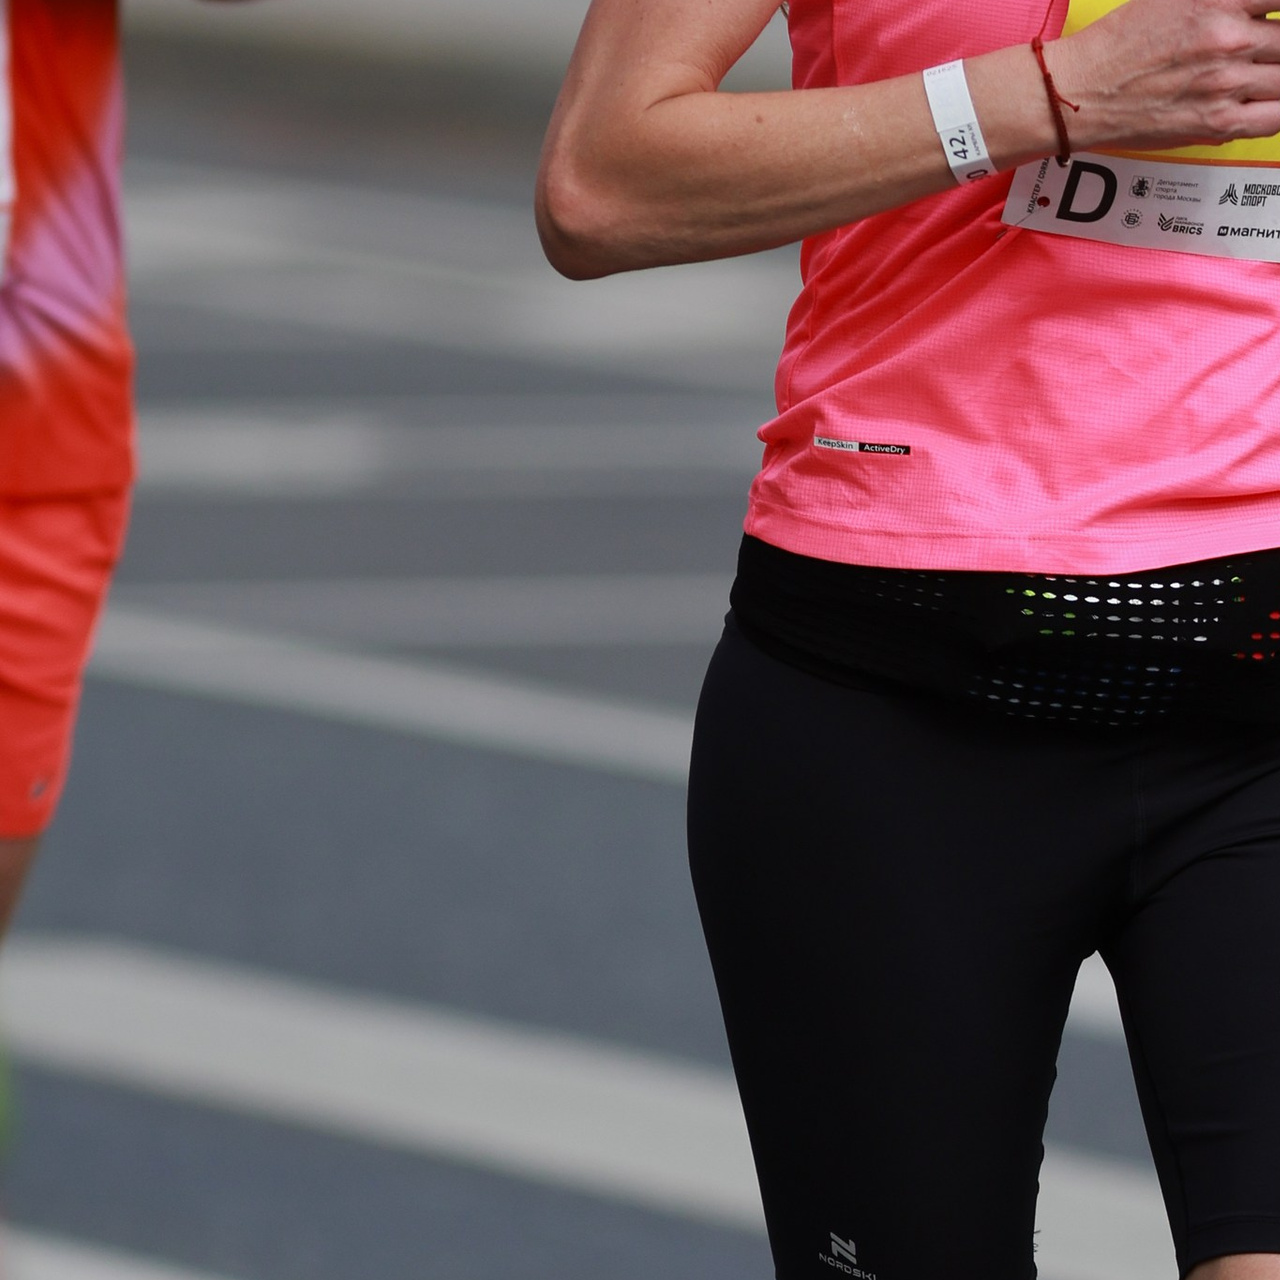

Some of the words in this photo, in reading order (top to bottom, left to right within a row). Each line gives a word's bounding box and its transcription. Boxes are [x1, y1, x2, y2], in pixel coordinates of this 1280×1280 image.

[1056, 159, 1118, 223] D
[1240, 195, 1267, 207] СПОРТ
[1172, 224, 1204, 236] BRICS
[817, 438, 854, 450] KeepSkin
[863, 443, 906, 455] ActiveDry
